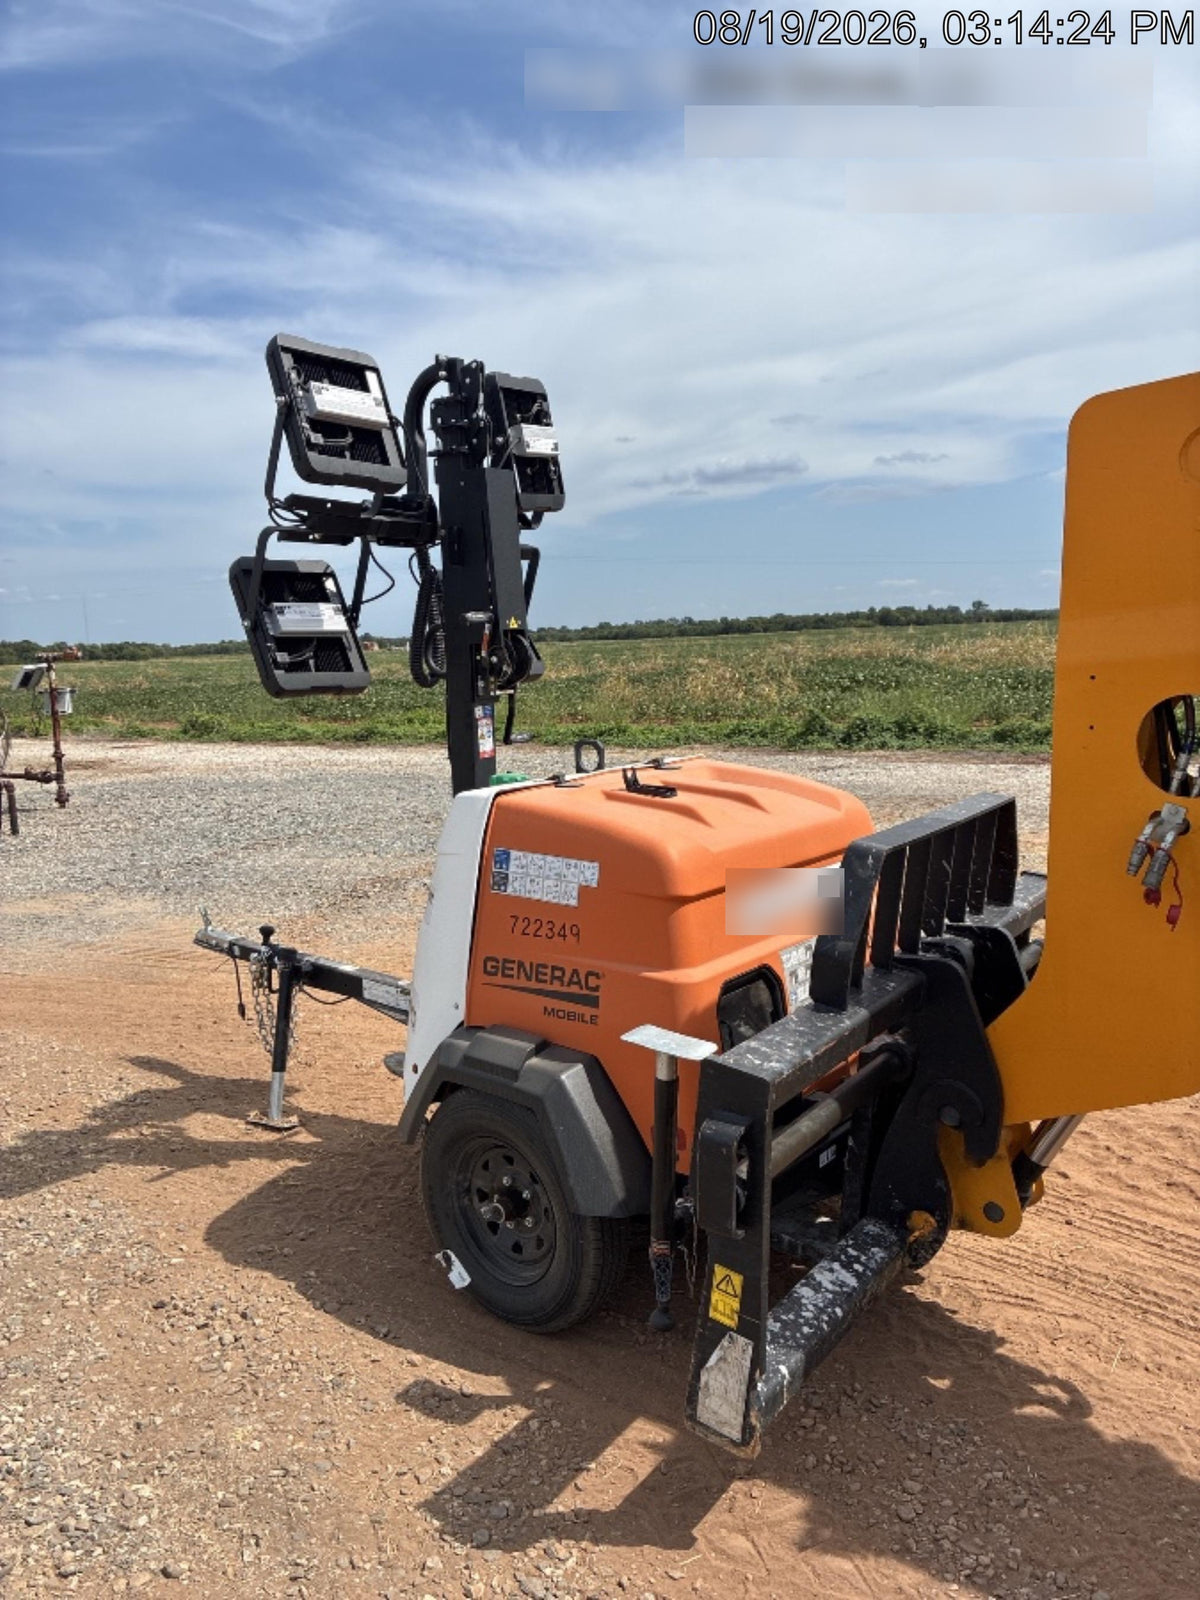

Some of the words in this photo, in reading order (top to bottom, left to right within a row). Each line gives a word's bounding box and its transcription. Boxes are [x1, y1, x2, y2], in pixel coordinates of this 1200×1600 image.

[509, 914, 581, 944] 722349
[482, 955, 602, 993] GENERAC
[543, 1006, 599, 1025] MOBILE
